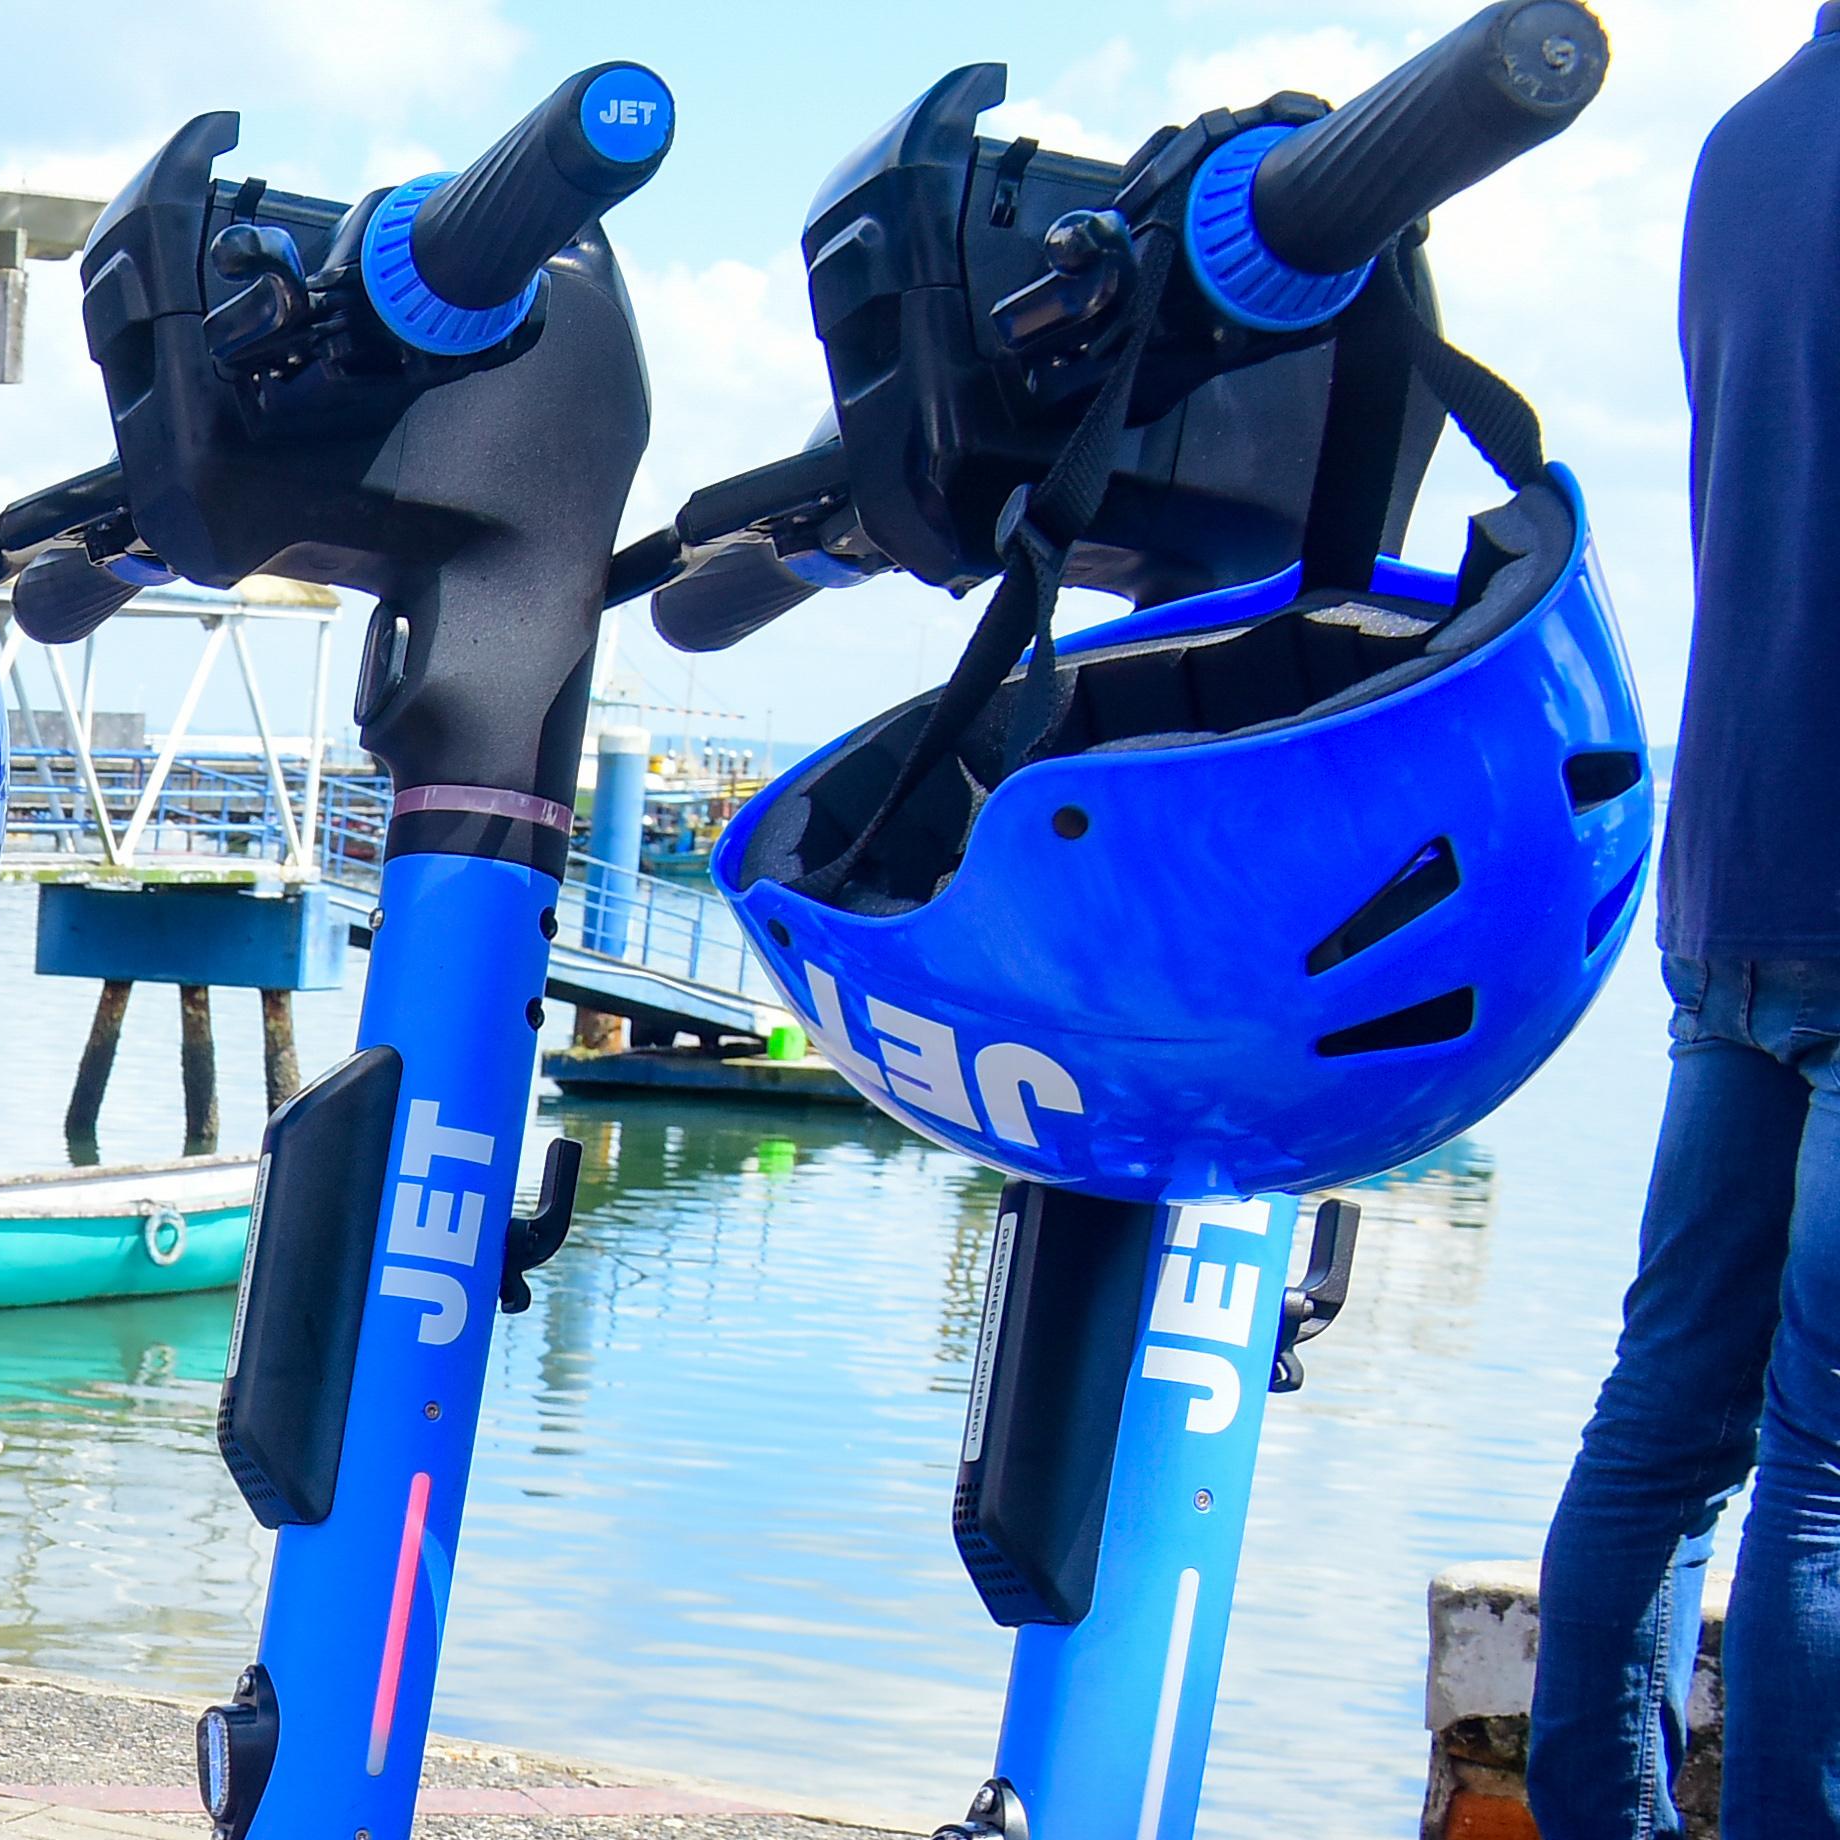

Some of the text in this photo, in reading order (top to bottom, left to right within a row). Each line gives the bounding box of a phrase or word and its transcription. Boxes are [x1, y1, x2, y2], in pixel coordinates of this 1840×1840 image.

[599, 98, 657, 127] JET
[804, 960, 1084, 1149] JET
[378, 1099, 496, 1346] JET
[969, 1227, 1010, 1444] DESIGNED BY NINEBOT
